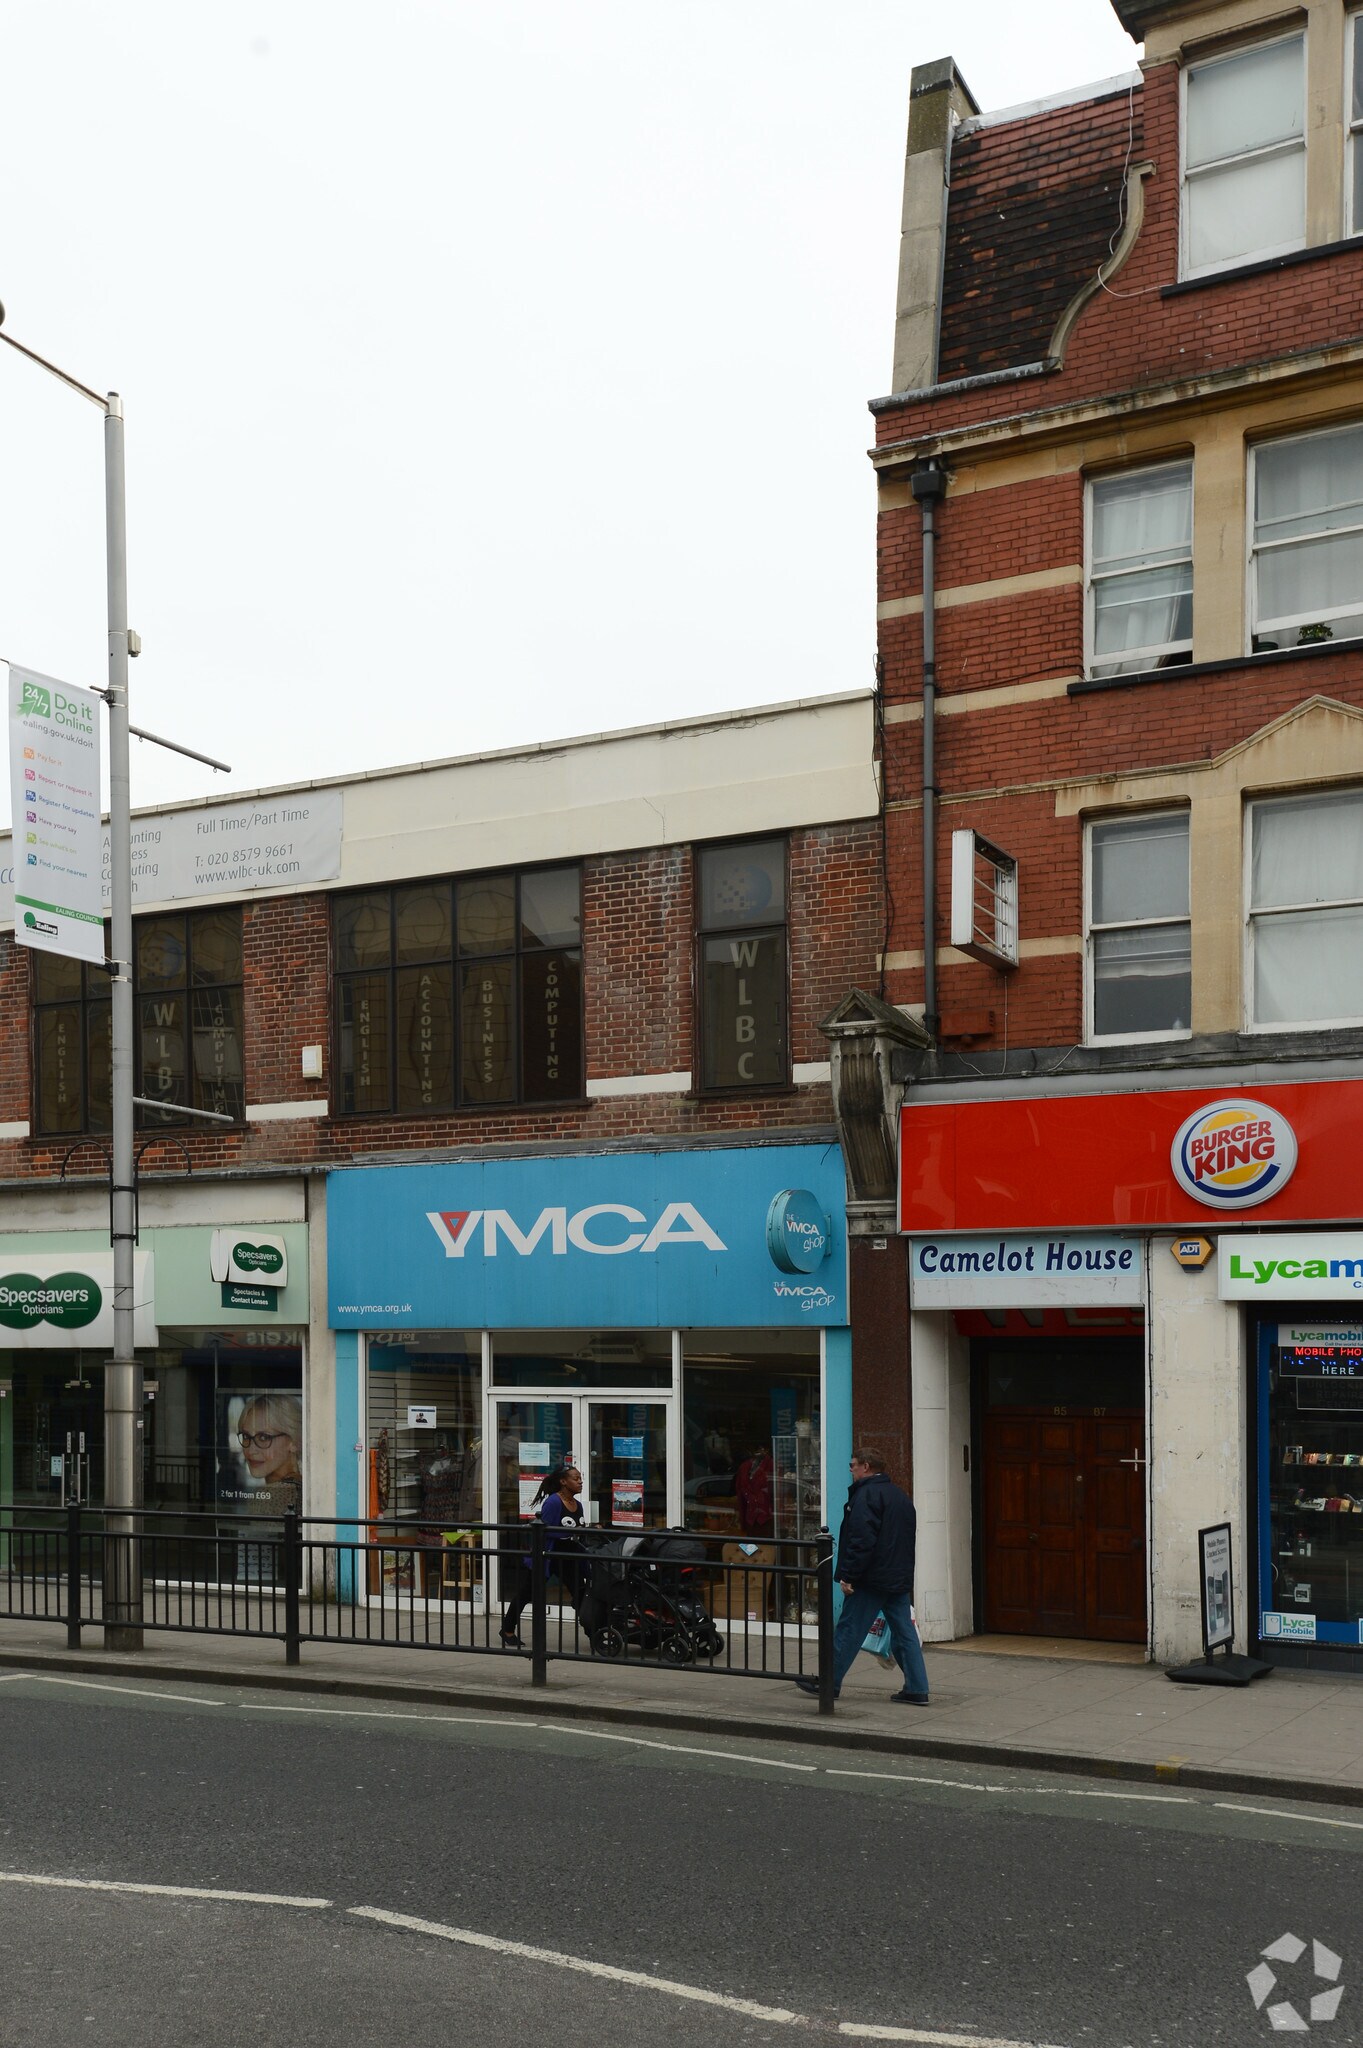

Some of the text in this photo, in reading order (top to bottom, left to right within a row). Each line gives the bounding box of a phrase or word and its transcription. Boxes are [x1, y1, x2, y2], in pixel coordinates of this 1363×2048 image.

[24, 685, 49, 714] 24/7
[55, 693, 92, 721] Do it
[55, 712, 93, 734] Online
[23, 720, 94, 749] ealing.gov.uk/doit
[38, 774, 57, 786] Report
[39, 794, 61, 808] Register
[62, 803, 71, 811] for
[72, 806, 95, 819] updates
[196, 808, 310, 835] Full Time/Part Time
[207, 852, 229, 866] 020
[232, 847, 261, 863] 8579
[265, 843, 294, 858] 9661
[39, 858, 52, 868] Find
[52, 863, 66, 872] your
[66, 868, 88, 879] nearest
[195, 860, 300, 884] www.wlbc-uk.com
[55, 906, 100, 924] EALING COUNCIL
[36, 922, 58, 935] Ealing
[545, 960, 560, 1079] COMPUTING
[730, 940, 760, 1080] WLBC
[420, 975, 433, 1103] ACCOUNTING
[482, 980, 495, 1083] BUSINESS
[360, 1000, 371, 1086] ENGLISH
[57, 1023, 67, 1103] ENGLISH
[1191, 1120, 1272, 1158] BURGER
[1195, 1136, 1276, 1182] KING
[425, 1202, 729, 1258] YMCA
[786, 1221, 820, 1236] YMCA
[237, 1248, 278, 1262] Specsavers
[919, 1242, 1133, 1273] Camelot House
[1180, 1243, 1200, 1254] ADT
[248, 1258, 268, 1266] Opticians
[0, 1286, 89, 1307] Specsavers
[230, 1296, 269, 1306] Contact Lenses
[233, 1287, 261, 1297] Spectacles
[773, 1286, 828, 1297] YMCA
[22, 1304, 64, 1316] Opticians
[337, 1303, 413, 1315] www.ymca.org.uk
[1295, 1346, 1335, 1356] MOBILE
[1322, 1366, 1355, 1375] HERE
[1053, 1406, 1067, 1416] 85
[239, 1491, 254, 1499] from
[256, 1491, 271, 1500] £69
[1282, 1616, 1314, 1628] Lyca
[1283, 1627, 1314, 1635] mobile
